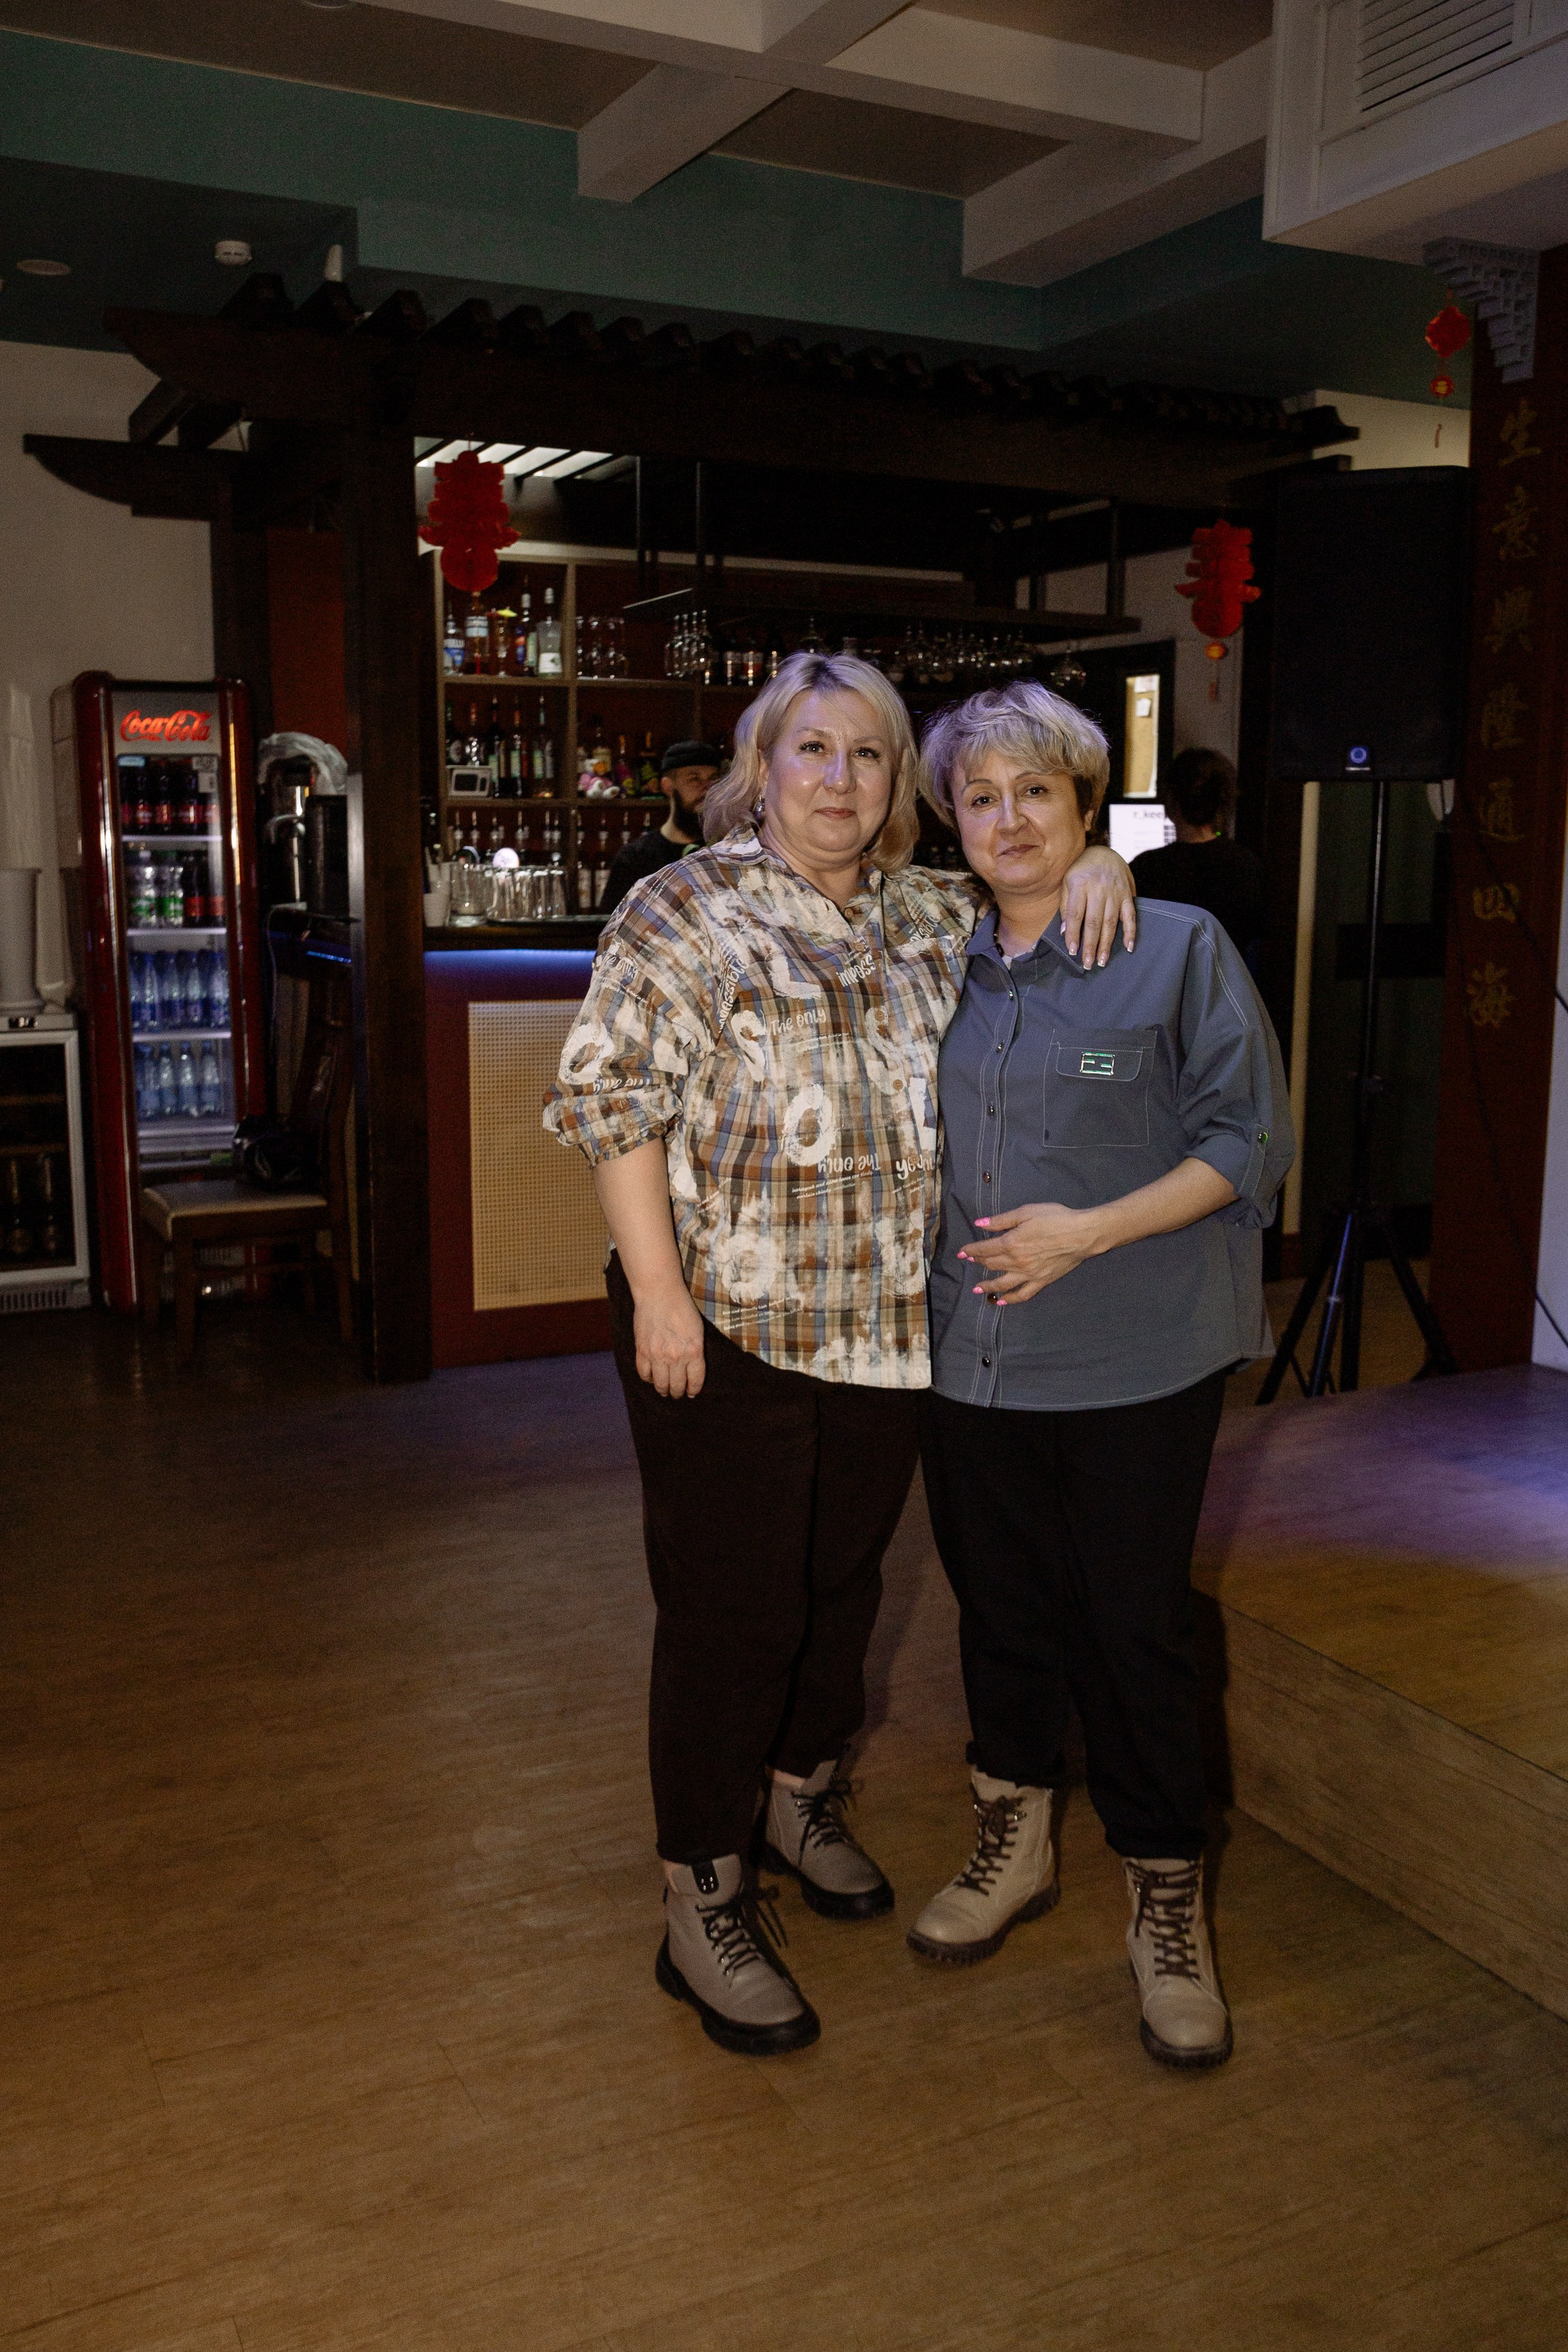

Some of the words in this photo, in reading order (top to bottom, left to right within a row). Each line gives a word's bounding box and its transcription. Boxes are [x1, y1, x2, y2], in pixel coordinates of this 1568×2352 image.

[120, 709, 212, 742] Coca-Cola
[770, 1017, 793, 1036] The
[796, 1008, 827, 1027] only
[857, 1152, 881, 1172] The
